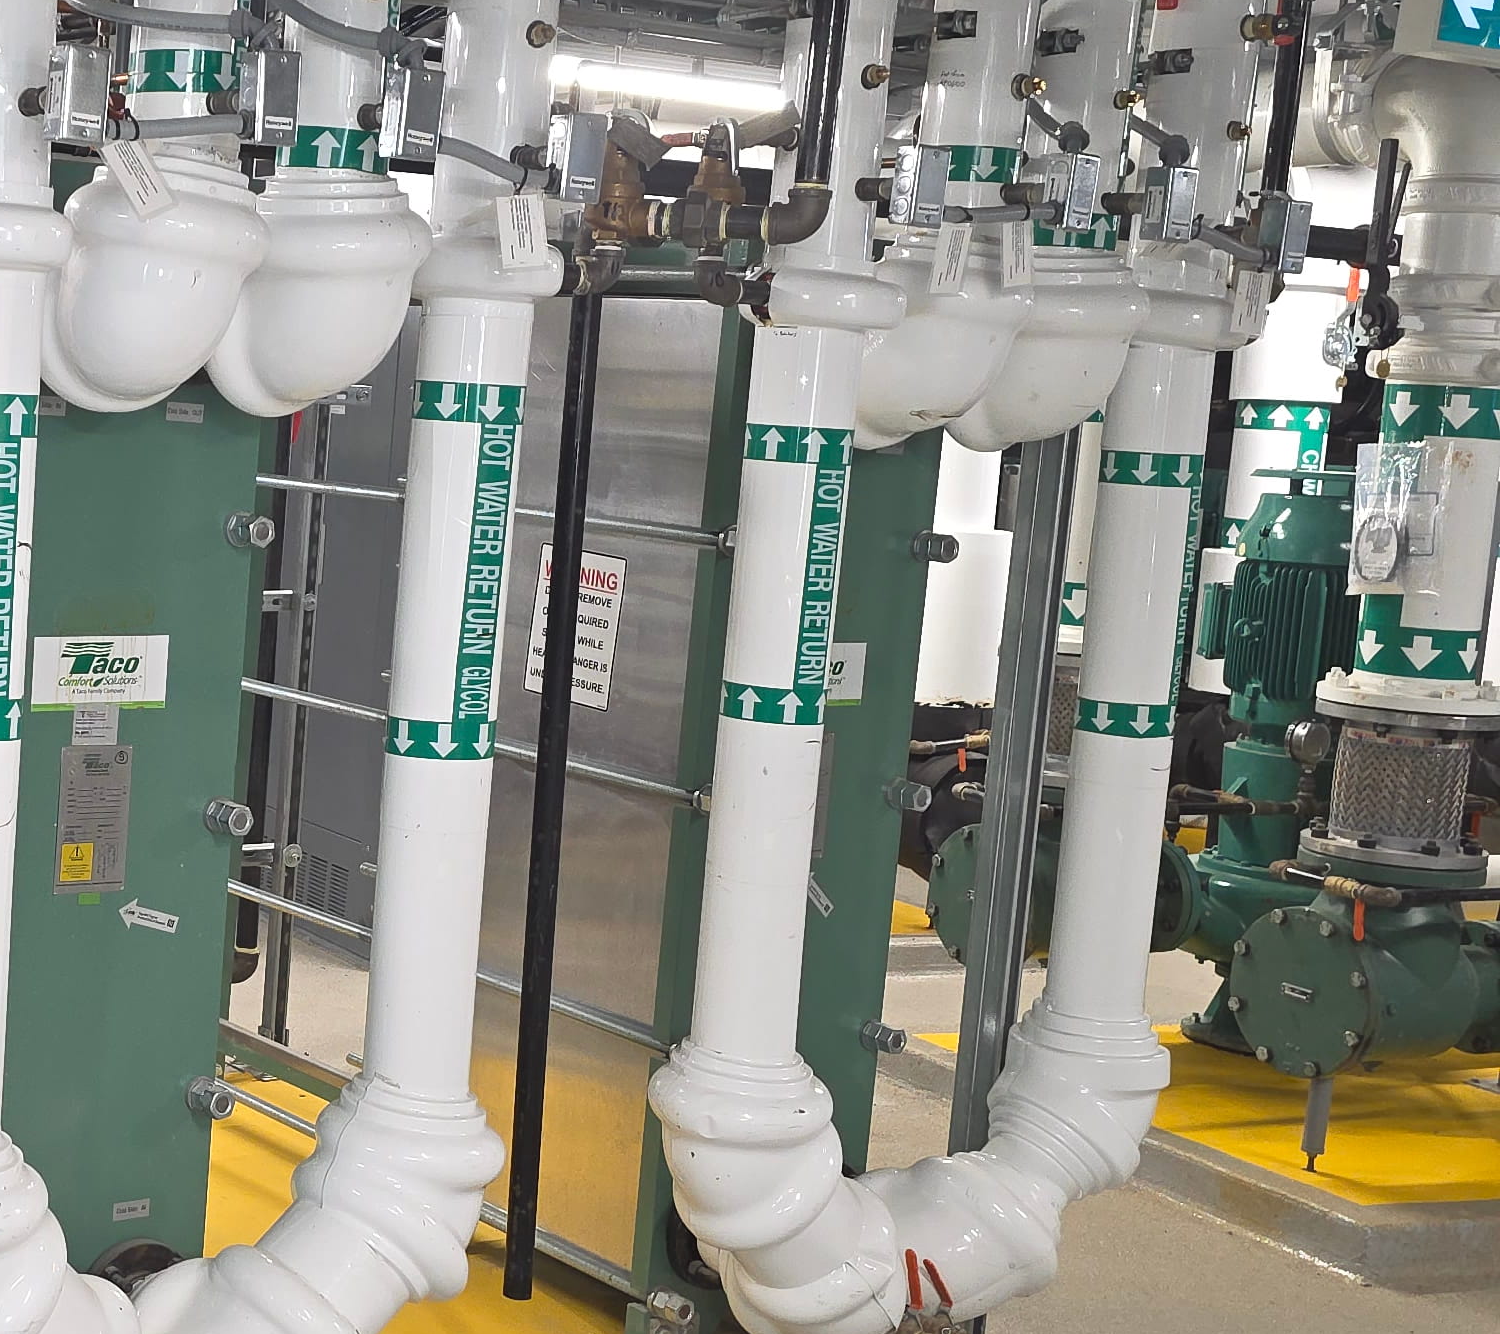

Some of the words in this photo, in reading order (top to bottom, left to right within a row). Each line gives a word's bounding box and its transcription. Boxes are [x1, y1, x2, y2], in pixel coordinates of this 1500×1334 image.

[481, 424, 514, 471] HOT
[815, 468, 845, 514] HOT
[472, 478, 509, 555] WATER
[807, 521, 841, 592] WATER
[462, 564, 501, 654] RETURN
[577, 593, 613, 609] REMOVE
[577, 615, 609, 630] QUIRED
[61, 642, 142, 674] Taco
[577, 636, 604, 651] WHILE
[798, 600, 833, 687] RETURN
[58, 675, 94, 688] Comfort
[102, 674, 139, 686] Solutions
[573, 657, 599, 671] ANGER
[600, 663, 608, 673] IS
[458, 666, 491, 720] GLYCOL
[572, 678, 605, 695] ESSURE.
